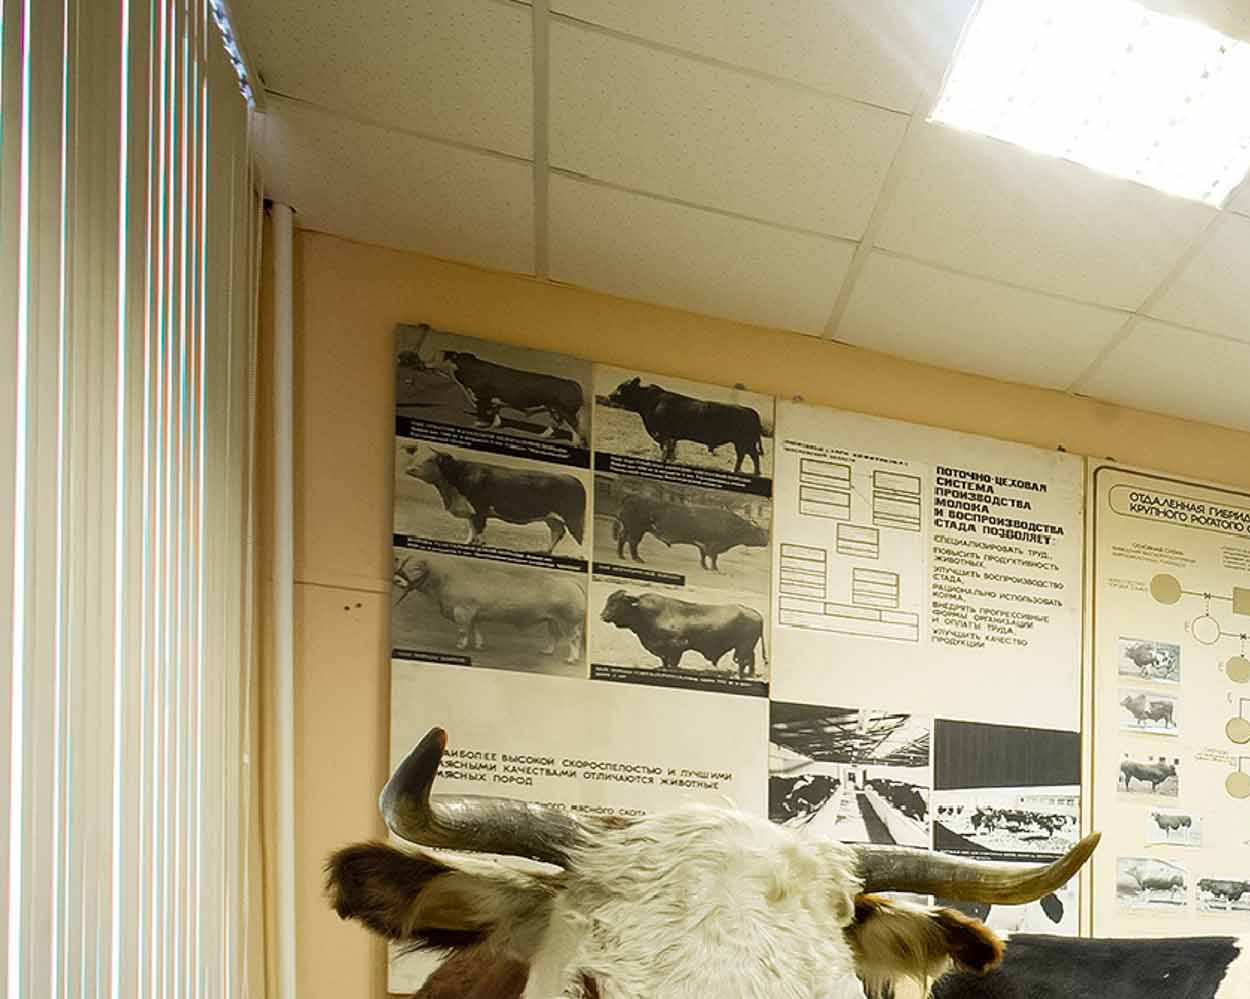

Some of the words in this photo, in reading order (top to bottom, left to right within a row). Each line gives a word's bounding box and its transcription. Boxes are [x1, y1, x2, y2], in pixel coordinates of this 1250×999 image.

[936, 466, 1047, 492] ПОТОЧНО-ЦЕХОВАЯ
[936, 476, 994, 494] СИСТЕМА
[934, 497, 990, 514] МОЛОКА
[935, 487, 1032, 510] ПРОИЗВОДСТВА
[1129, 491, 1205, 514] ОТДАЛЕННАЯ
[934, 508, 943, 517] И
[948, 509, 1064, 535] ВОСПРОИЗВОДСТВА
[934, 518, 976, 532] СТАДА
[1130, 502, 1188, 522] КРУПНОГО
[1191, 515, 1244, 532] РОГАТОГО
[983, 573, 1064, 590] ВОСПРОИЗВОДСТВО
[442, 749, 497, 761] АИБОЛЕЕ
[562, 759, 662, 775] СКОРОСПЕЛОСТЬЮ
[667, 768, 676, 776] И
[681, 769, 733, 781] ЛУЧШИМИ
[493, 774, 534, 786] ПОРОД
[503, 765, 577, 778] КАЧЕСТВАМИ
[583, 771, 654, 784] ОТЛИЧАЮТСЯ
[660, 779, 719, 790] ЖИВОТНЫЕ
